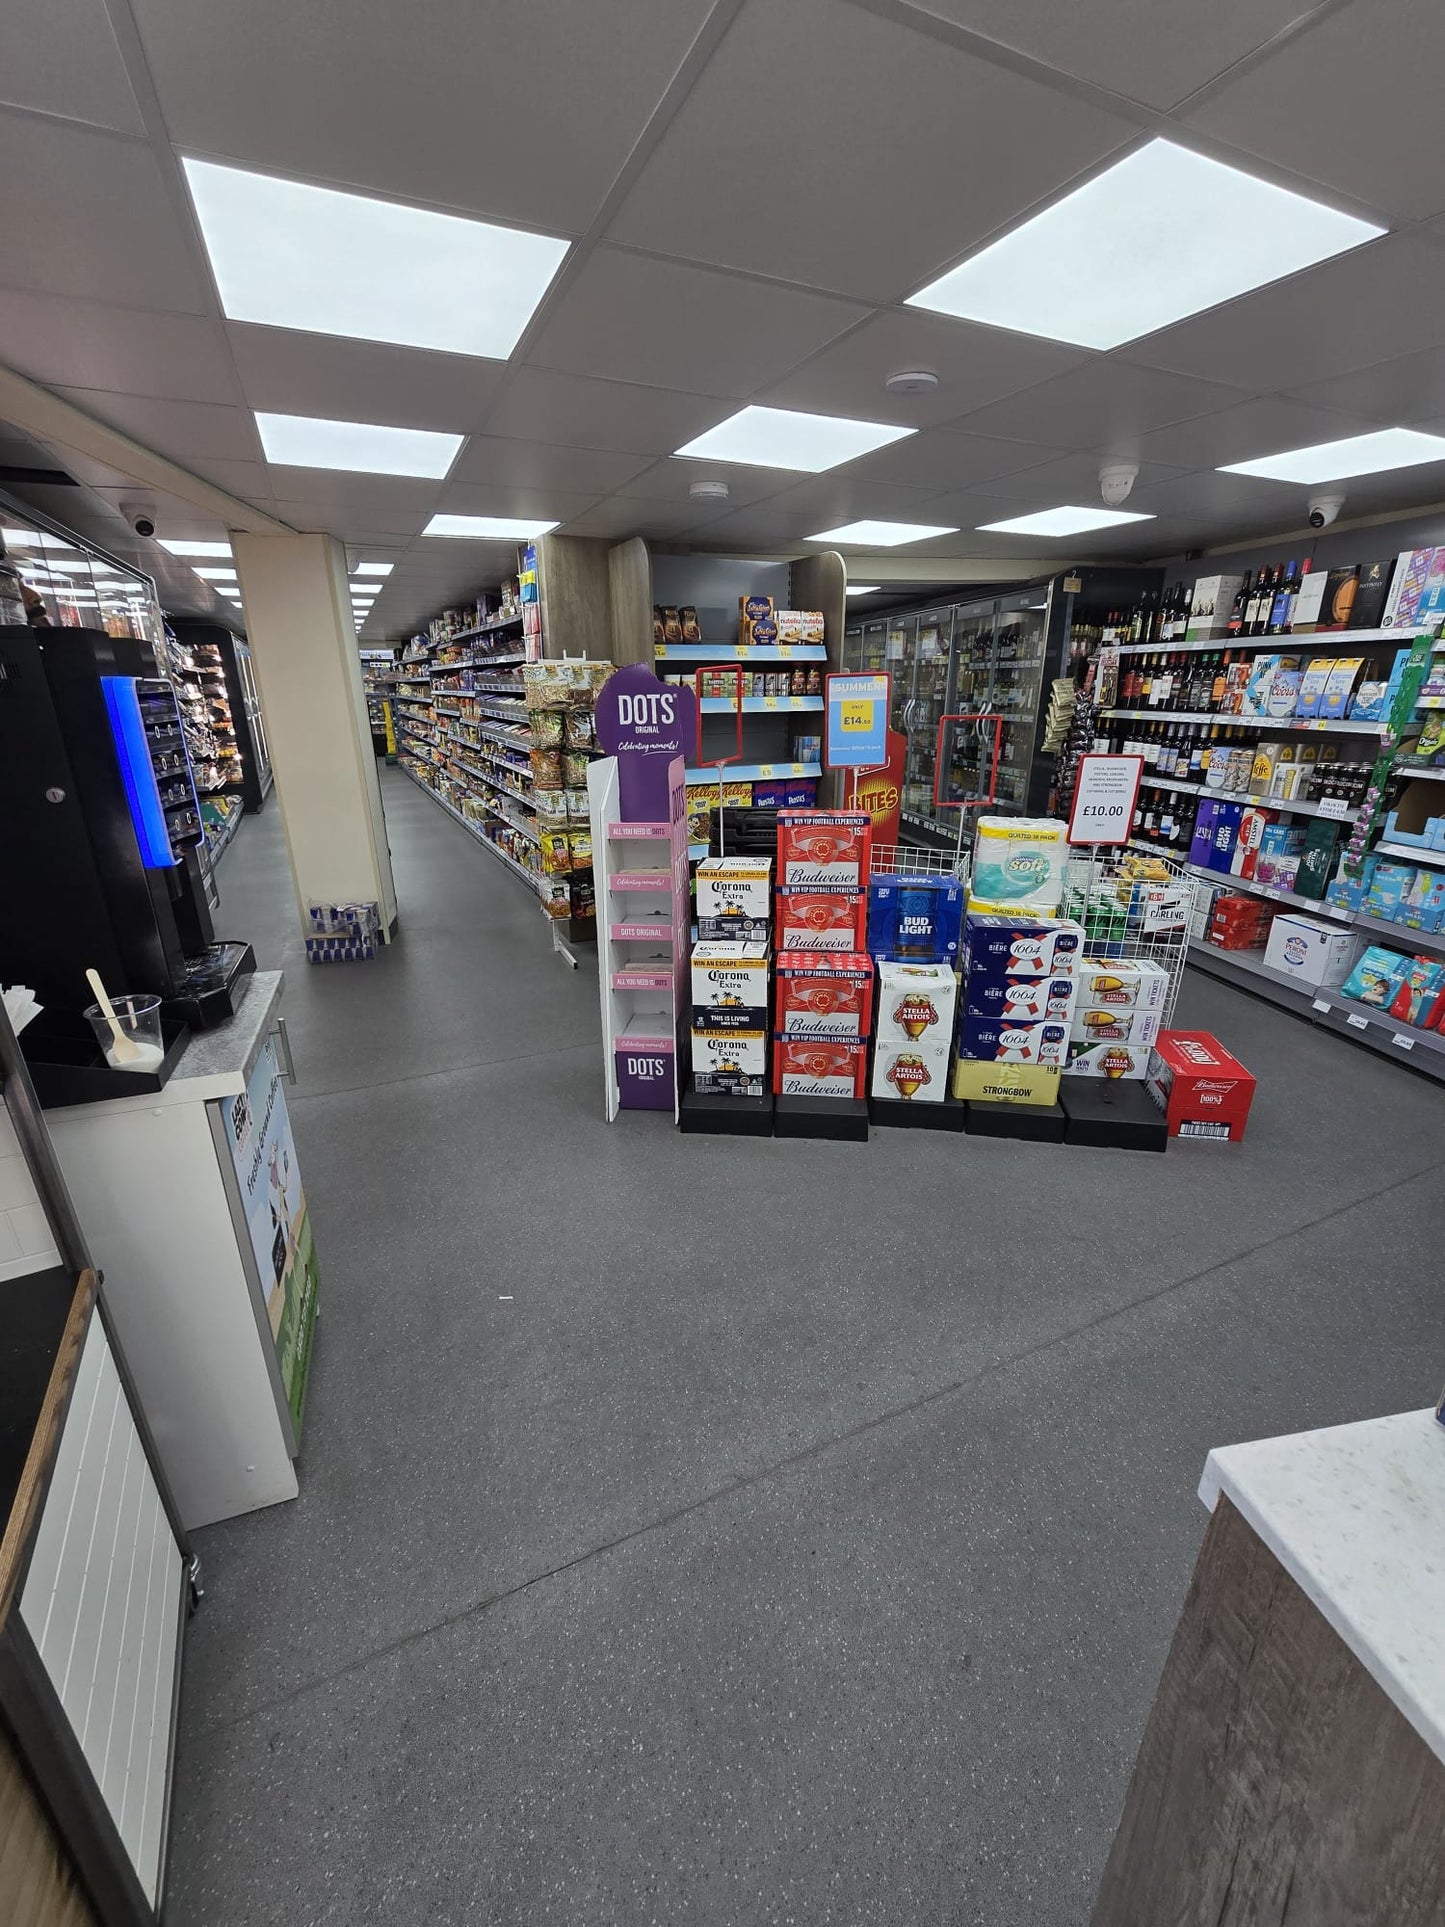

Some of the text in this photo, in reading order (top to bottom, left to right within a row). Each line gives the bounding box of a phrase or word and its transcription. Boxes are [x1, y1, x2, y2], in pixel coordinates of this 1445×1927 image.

[833, 682, 881, 692] SUMMER
[1272, 686, 1295, 697] Coors
[618, 694, 676, 725] DOTS
[635, 726, 660, 734] ORIGINAL
[618, 740, 679, 753] Celebrating moments!
[849, 787, 899, 814] BITES
[1083, 806, 1123, 816] £10.00
[1216, 828, 1225, 848] BUD
[1220, 826, 1232, 852] LIGHT
[1008, 858, 1044, 873] soft
[788, 868, 855, 884] Budweiser
[711, 881, 752, 893] Corona
[722, 891, 744, 900] Extra
[904, 917, 929, 925] BUD
[1150, 910, 1184, 920] CARLING
[620, 928, 662, 936] DOTS ORIGINAL
[899, 925, 933, 934] LIGHT
[785, 934, 852, 949] Budweiser
[1014, 943, 1041, 954] 1664
[1285, 943, 1307, 956] PERONI
[708, 969, 751, 982] Corona
[1008, 990, 1036, 1000] 1664
[788, 1018, 856, 1032] Budweiser
[708, 1039, 749, 1050] Corona
[1002, 1035, 1029, 1044] 1664
[718, 1049, 740, 1057] Extra
[627, 1058, 664, 1076] DOTS
[784, 1079, 852, 1095] Budweiser
[982, 1085, 1033, 1097] STRONGBOW
[231, 1094, 248, 1125] LAZY
[235, 1107, 248, 1141] COW
[247, 1146, 263, 1196] Freshly
